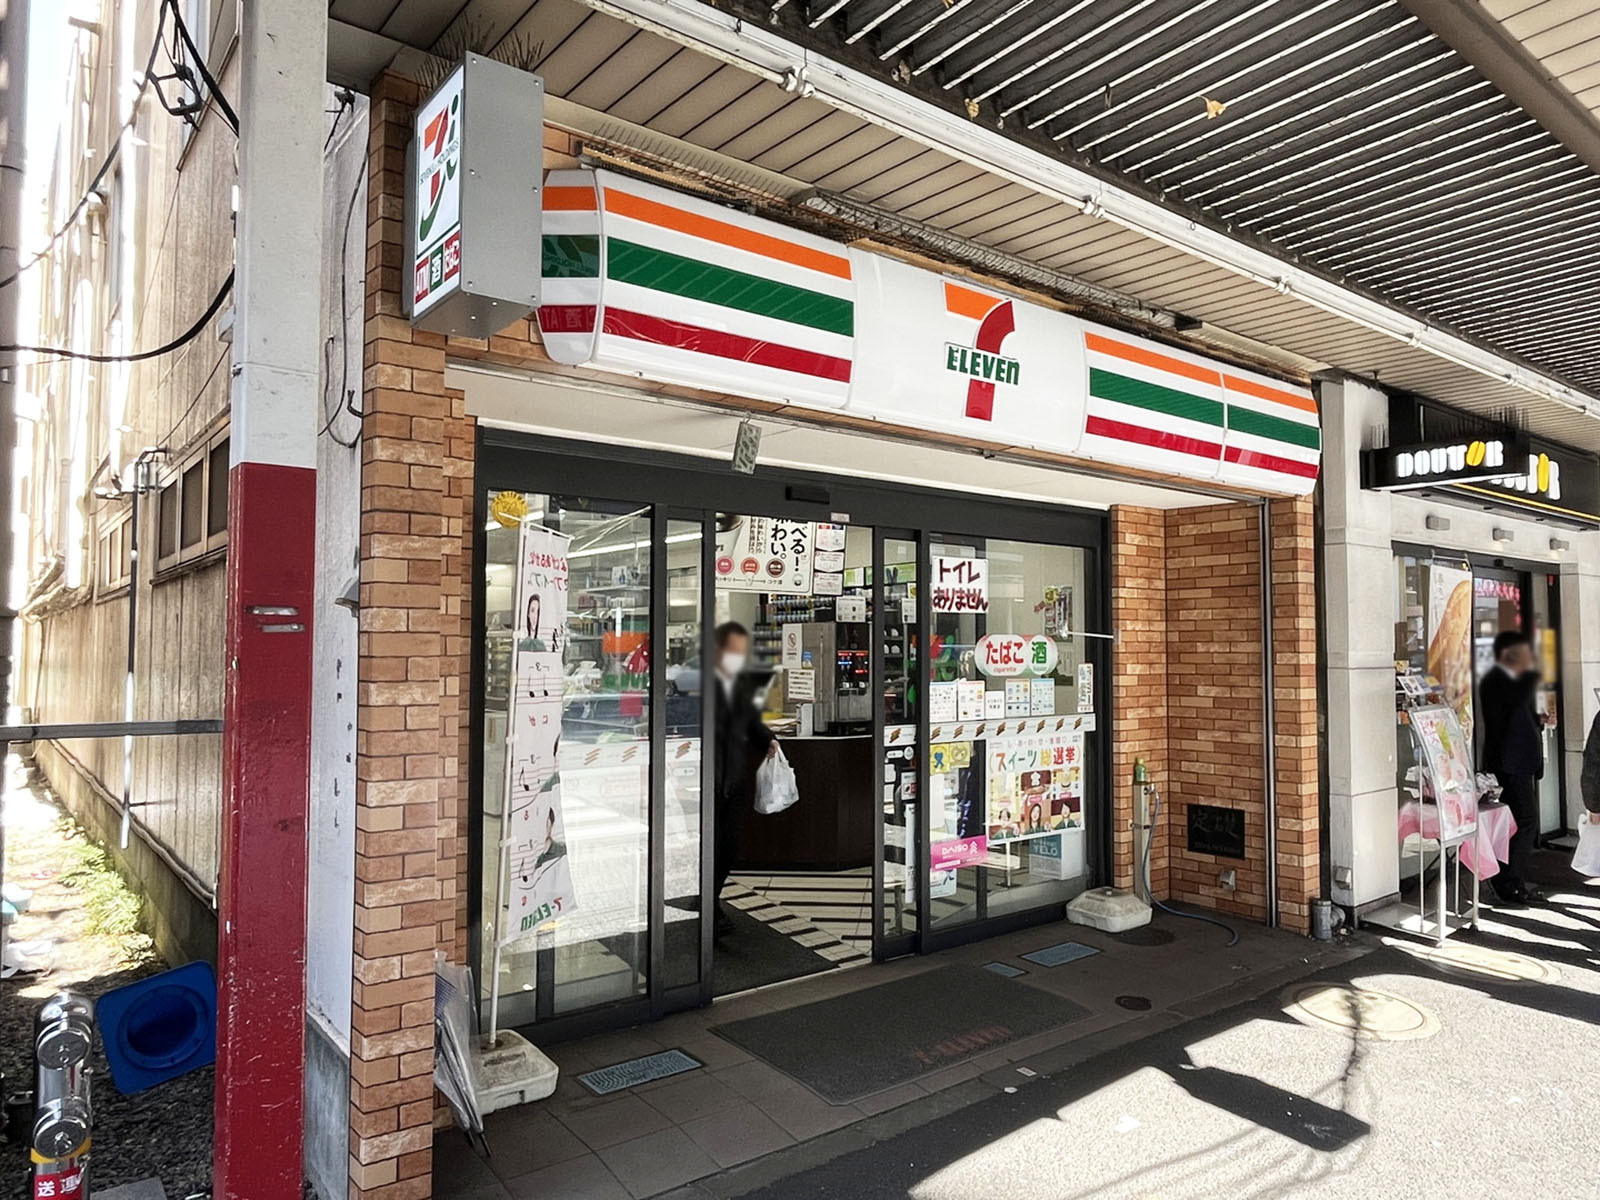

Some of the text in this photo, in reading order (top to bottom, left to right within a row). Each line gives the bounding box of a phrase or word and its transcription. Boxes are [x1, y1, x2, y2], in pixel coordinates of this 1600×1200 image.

[1396, 440, 1504, 478] DOUTOR
[938, 558, 981, 583] トイレ
[932, 586, 988, 612] ありません
[986, 640, 1025, 665] たばこ
[1031, 641, 1047, 664] 酒
